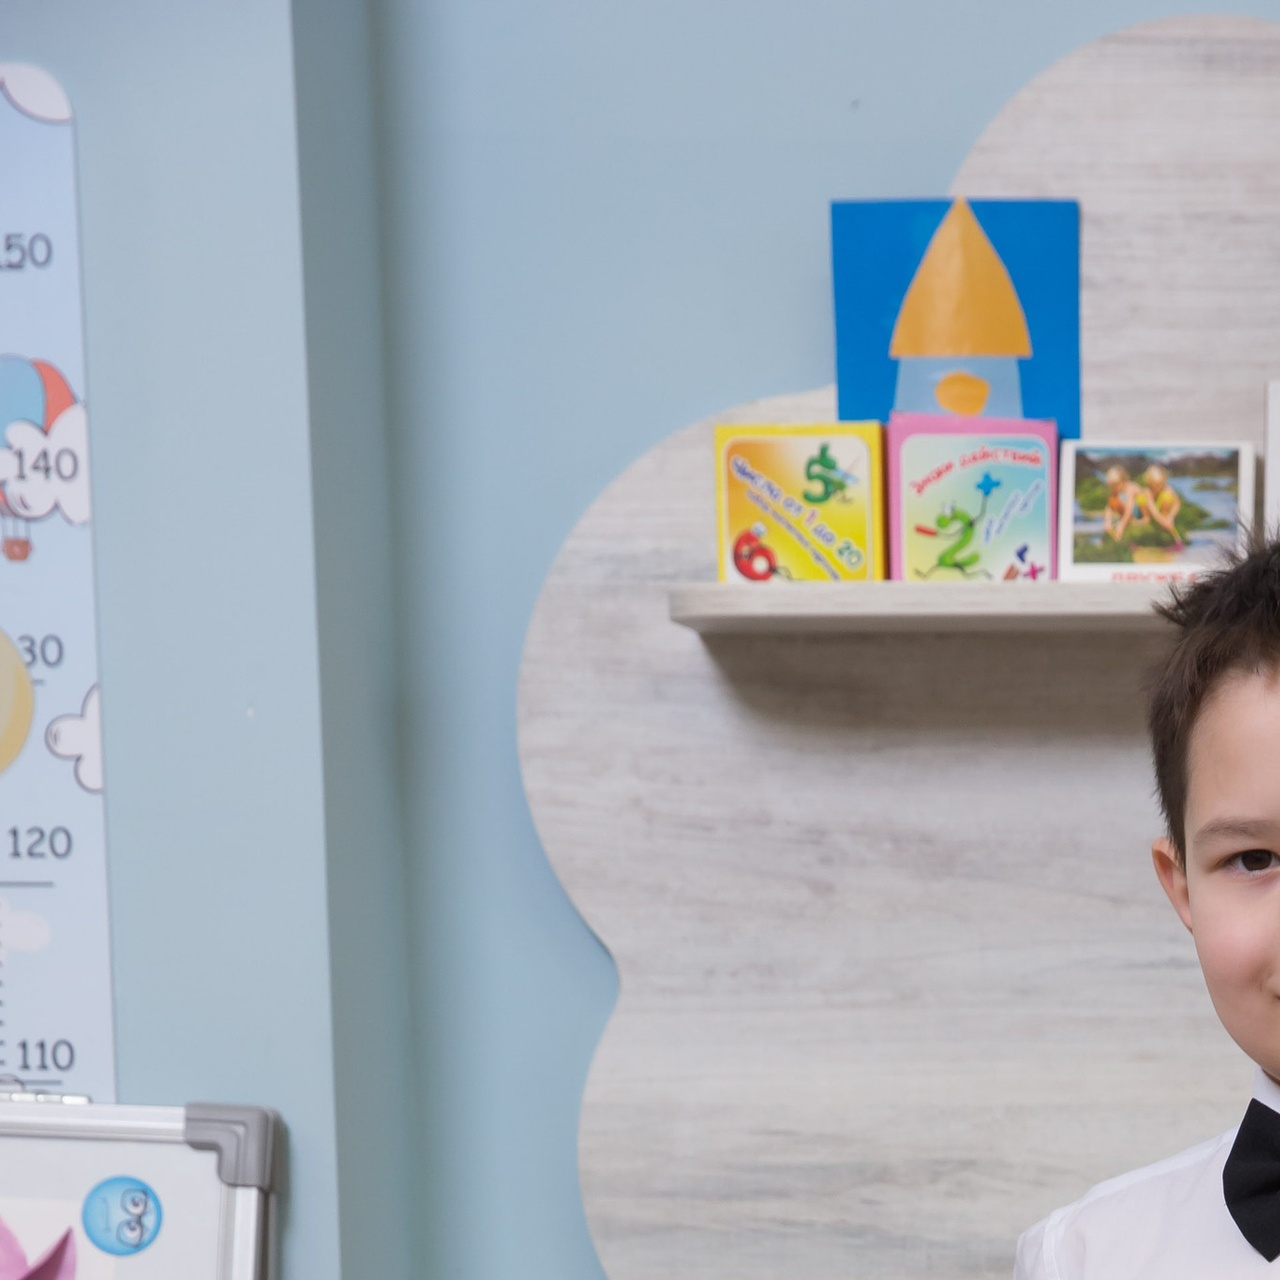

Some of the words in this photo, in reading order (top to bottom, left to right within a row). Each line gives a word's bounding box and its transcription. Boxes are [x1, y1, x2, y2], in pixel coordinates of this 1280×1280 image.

[0, 232, 53, 270] 50
[14, 447, 79, 480] 140
[838, 539, 863, 570] 20
[7, 825, 73, 860] 120
[18, 1038, 75, 1071] 110
